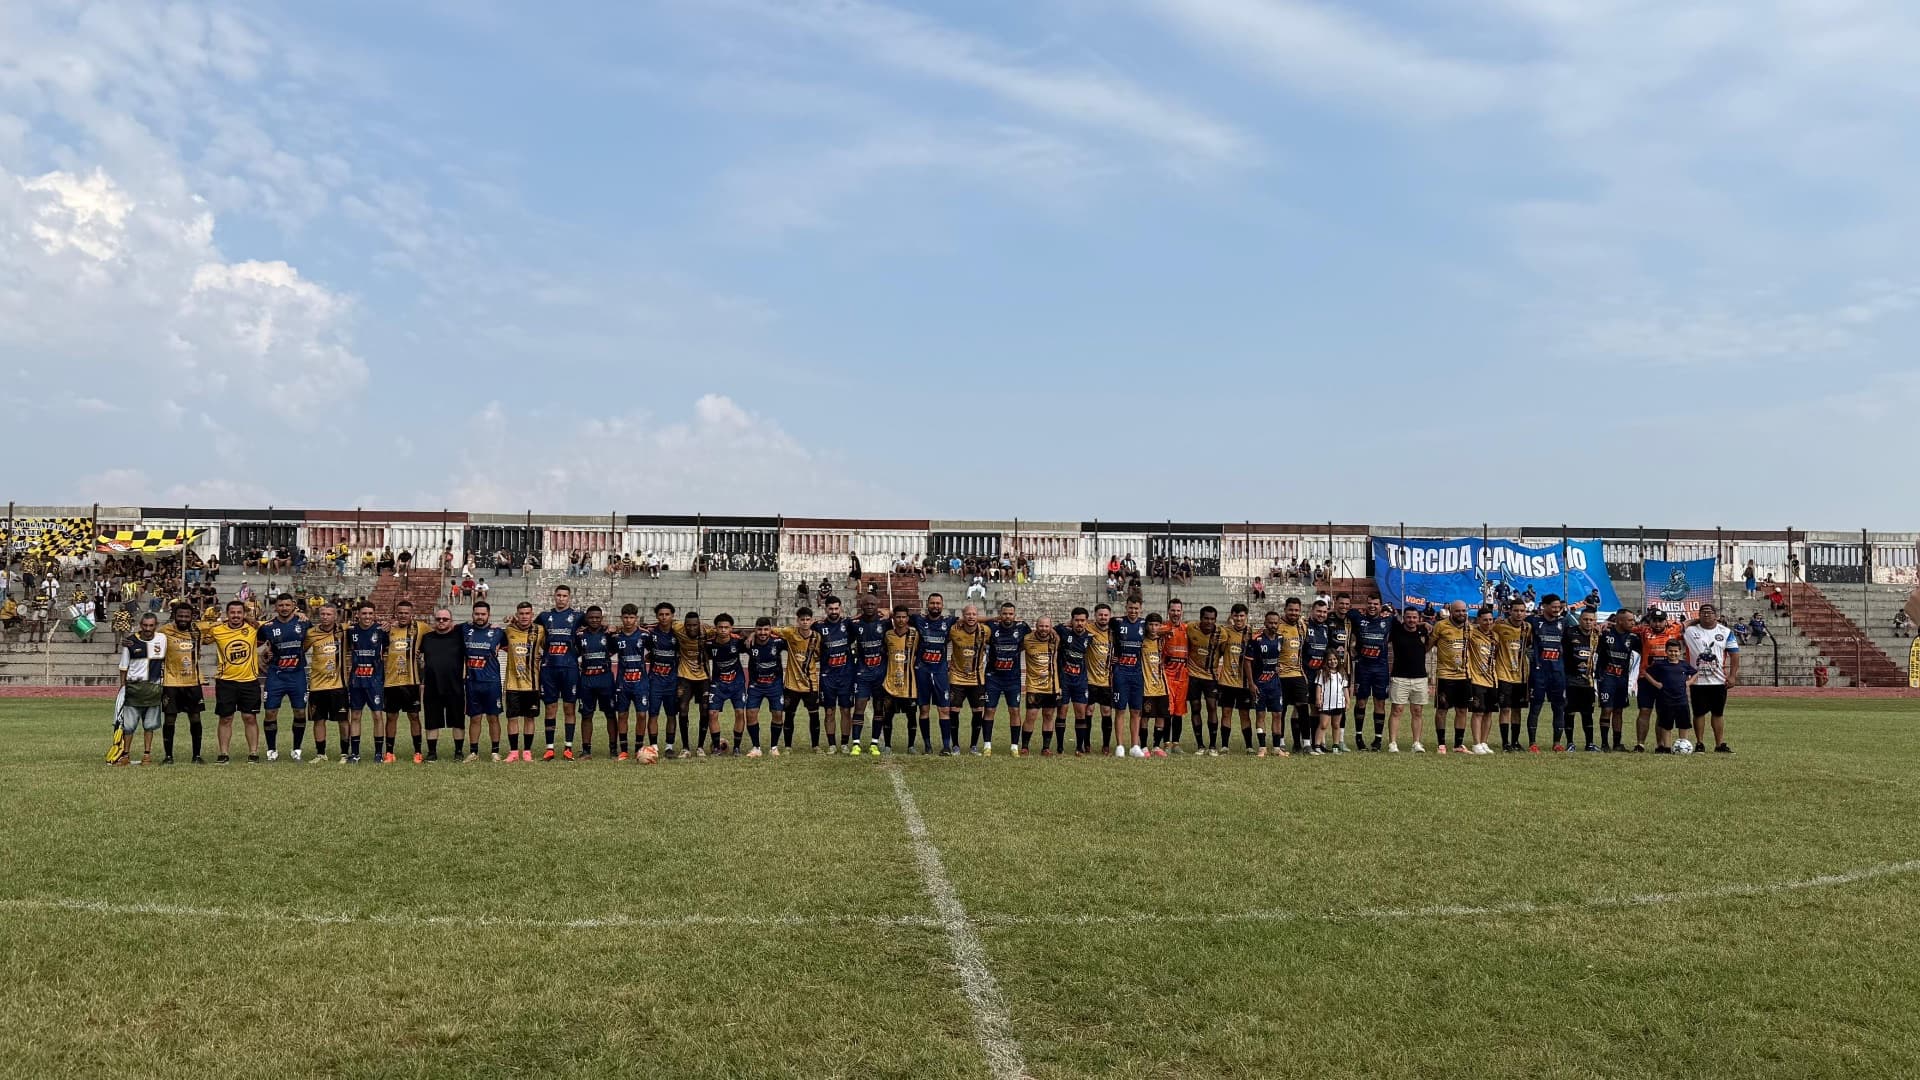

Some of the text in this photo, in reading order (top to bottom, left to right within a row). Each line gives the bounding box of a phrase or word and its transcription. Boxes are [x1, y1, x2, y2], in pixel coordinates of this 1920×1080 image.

[1387, 543, 1473, 573] TORCIDA
[1478, 546, 1560, 578] CAMISA
[1538, 621, 1544, 629] 7
[272, 628, 281, 637] 18
[468, 628, 474, 636] 2
[858, 627, 864, 635] 9
[1120, 626, 1128, 634] 21
[352, 633, 359, 642] 15
[1605, 635, 1615, 644] 20
[617, 640, 626, 649] 23
